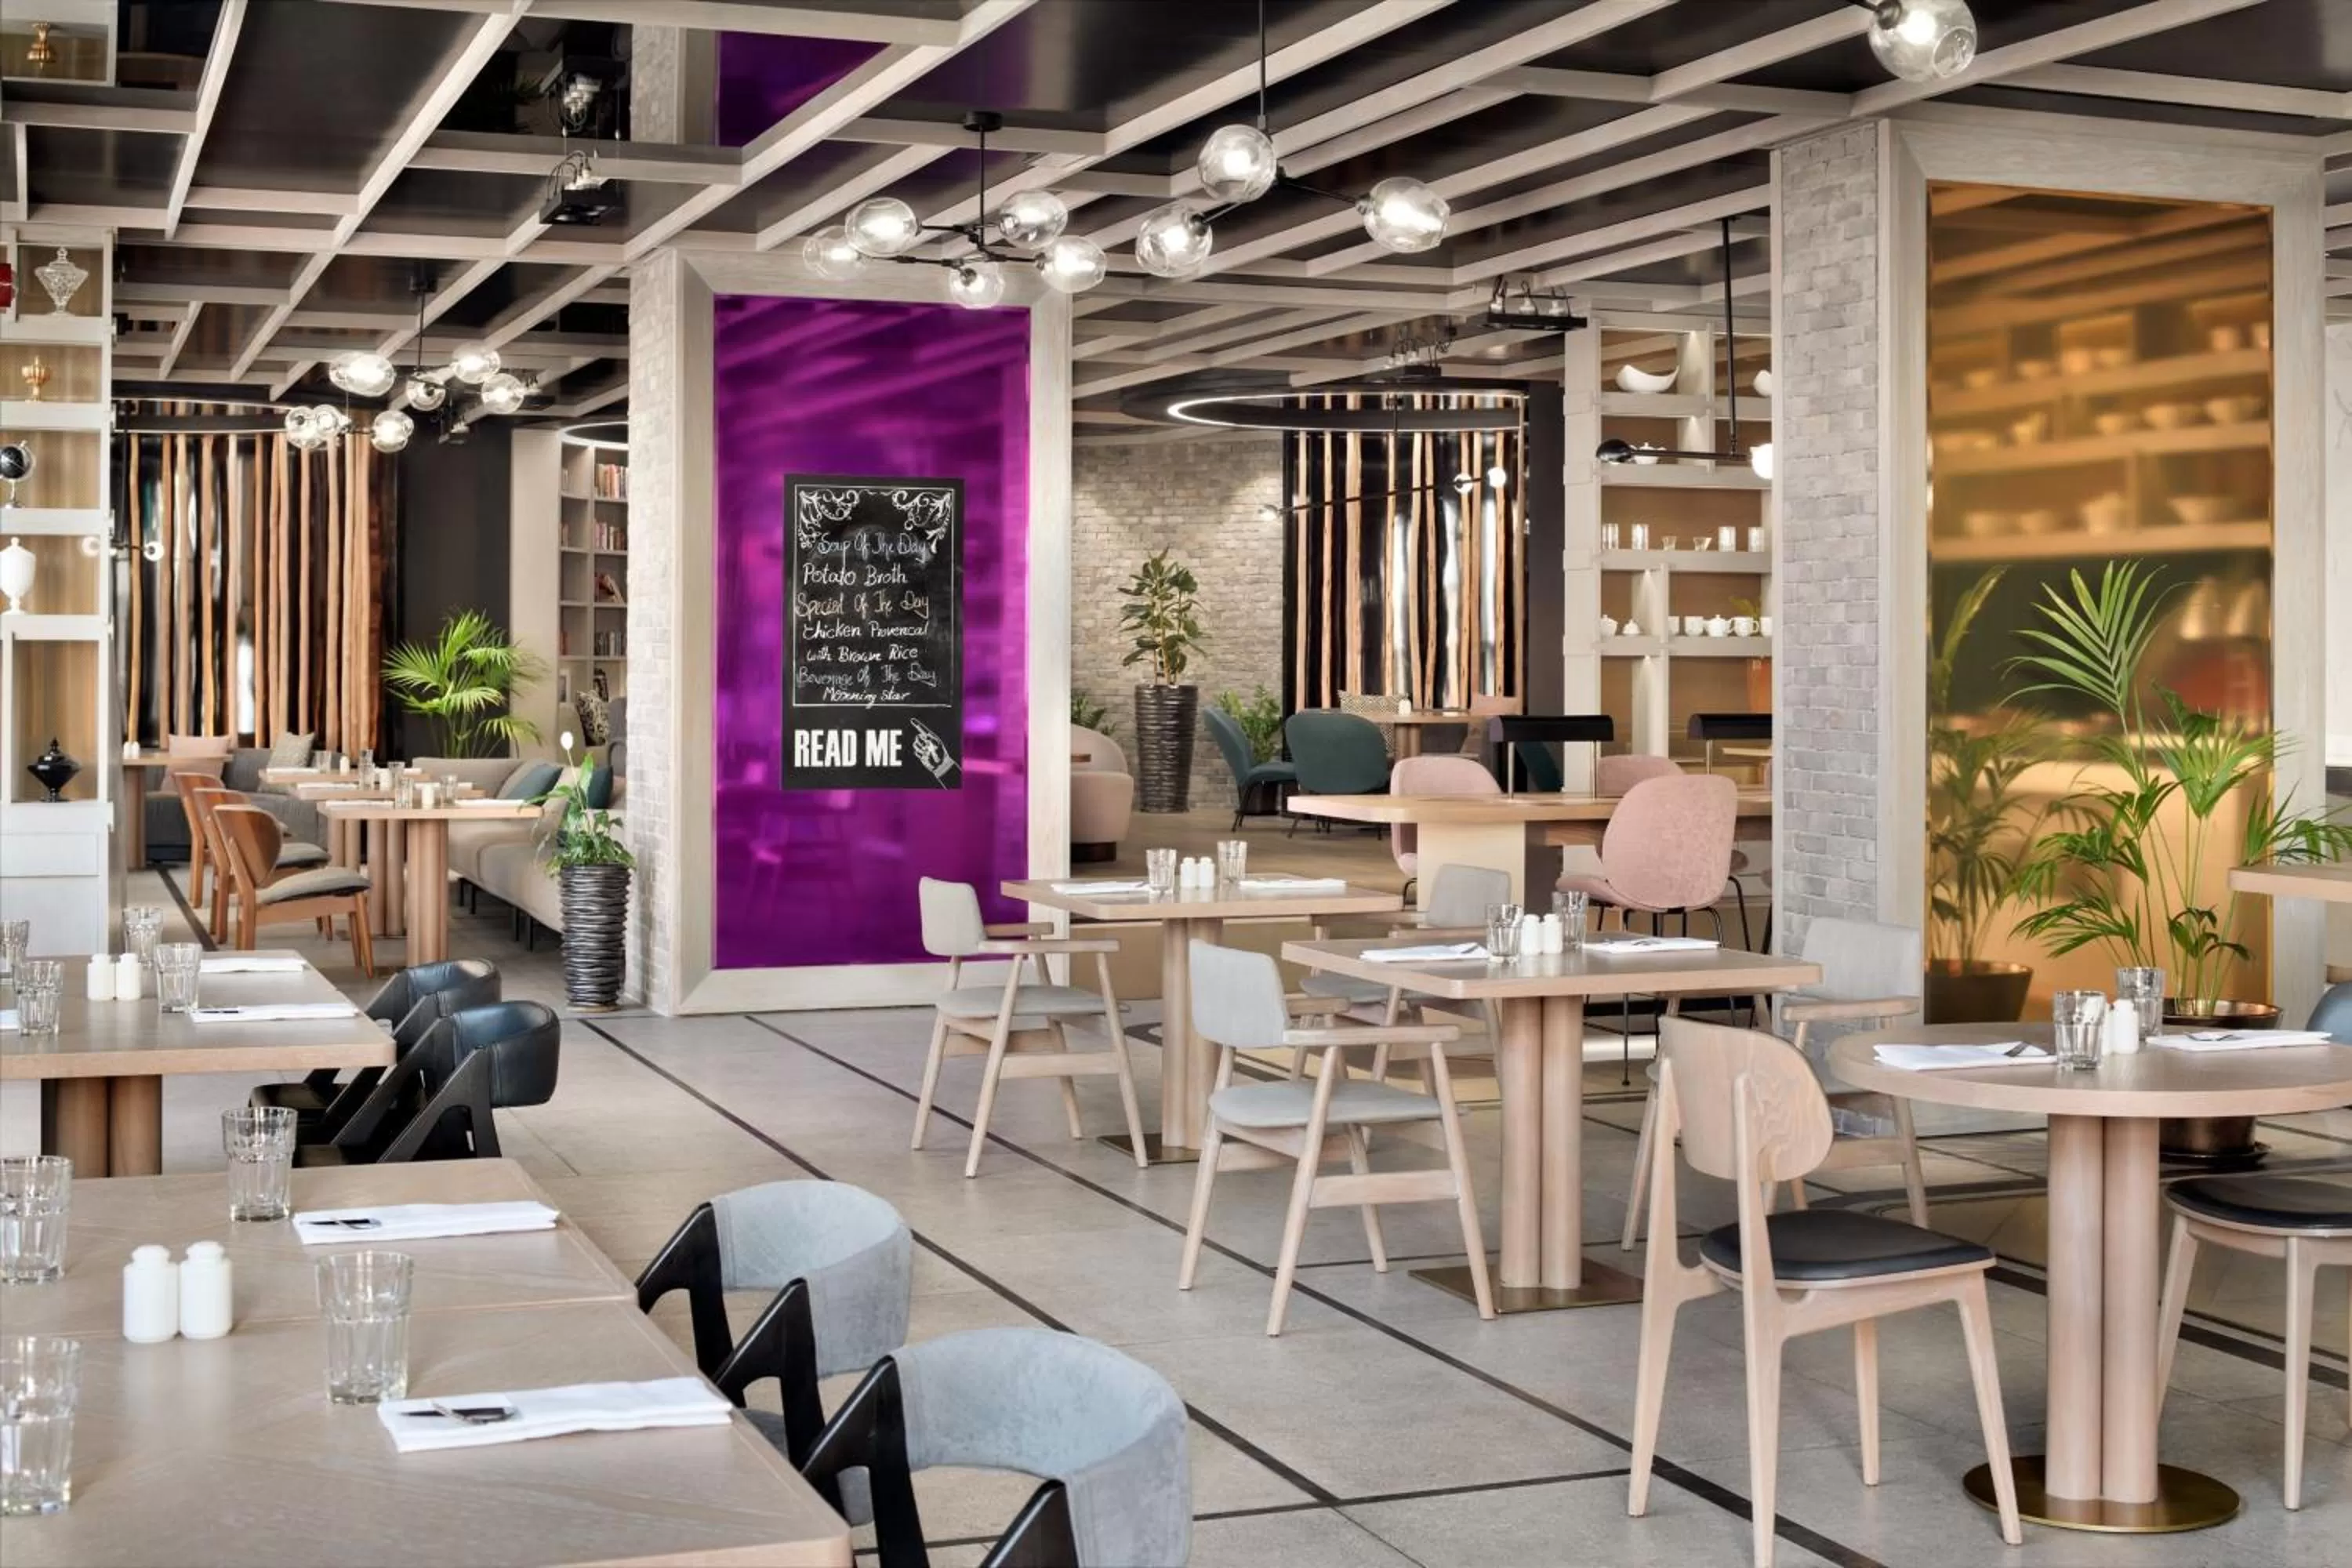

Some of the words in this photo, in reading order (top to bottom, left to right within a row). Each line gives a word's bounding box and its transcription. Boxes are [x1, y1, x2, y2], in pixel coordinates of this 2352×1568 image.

[897, 532, 927, 564] Day
[803, 562, 856, 586] Potato
[863, 562, 908, 586] Broth
[900, 590, 929, 619] Day
[807, 646, 832, 662] with
[888, 644, 918, 659] Rice
[907, 662, 937, 687] Day
[794, 729, 857, 768] READ
[866, 729, 902, 768] ME
